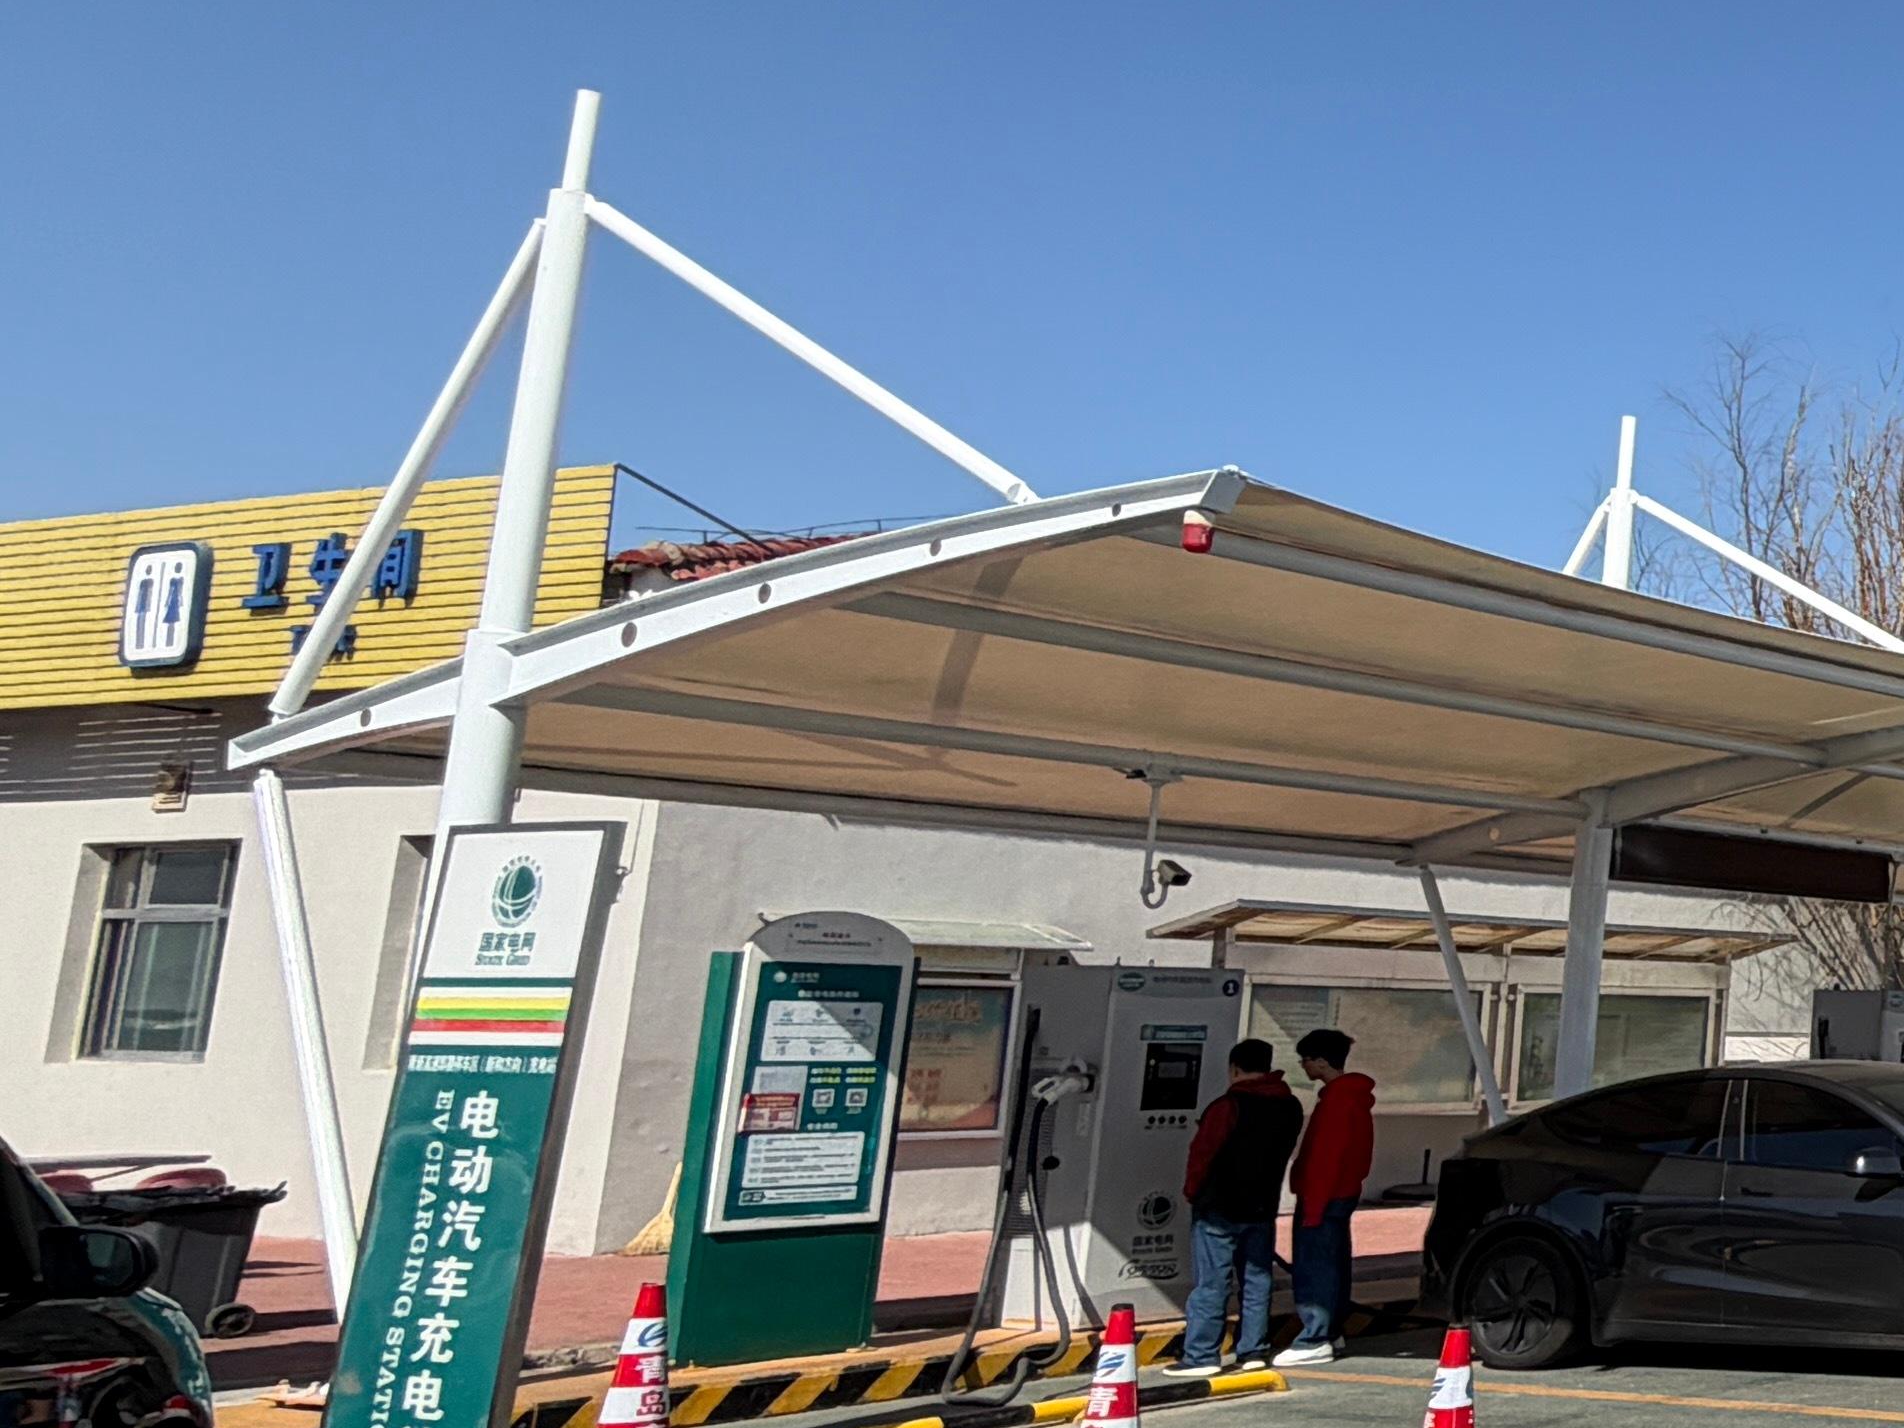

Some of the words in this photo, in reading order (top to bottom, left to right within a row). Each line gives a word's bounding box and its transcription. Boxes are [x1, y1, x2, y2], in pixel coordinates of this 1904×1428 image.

[479, 932, 536, 953] 国家电网
[432, 1089, 455, 1133] EV
[392, 1140, 444, 1318] CHARGING
